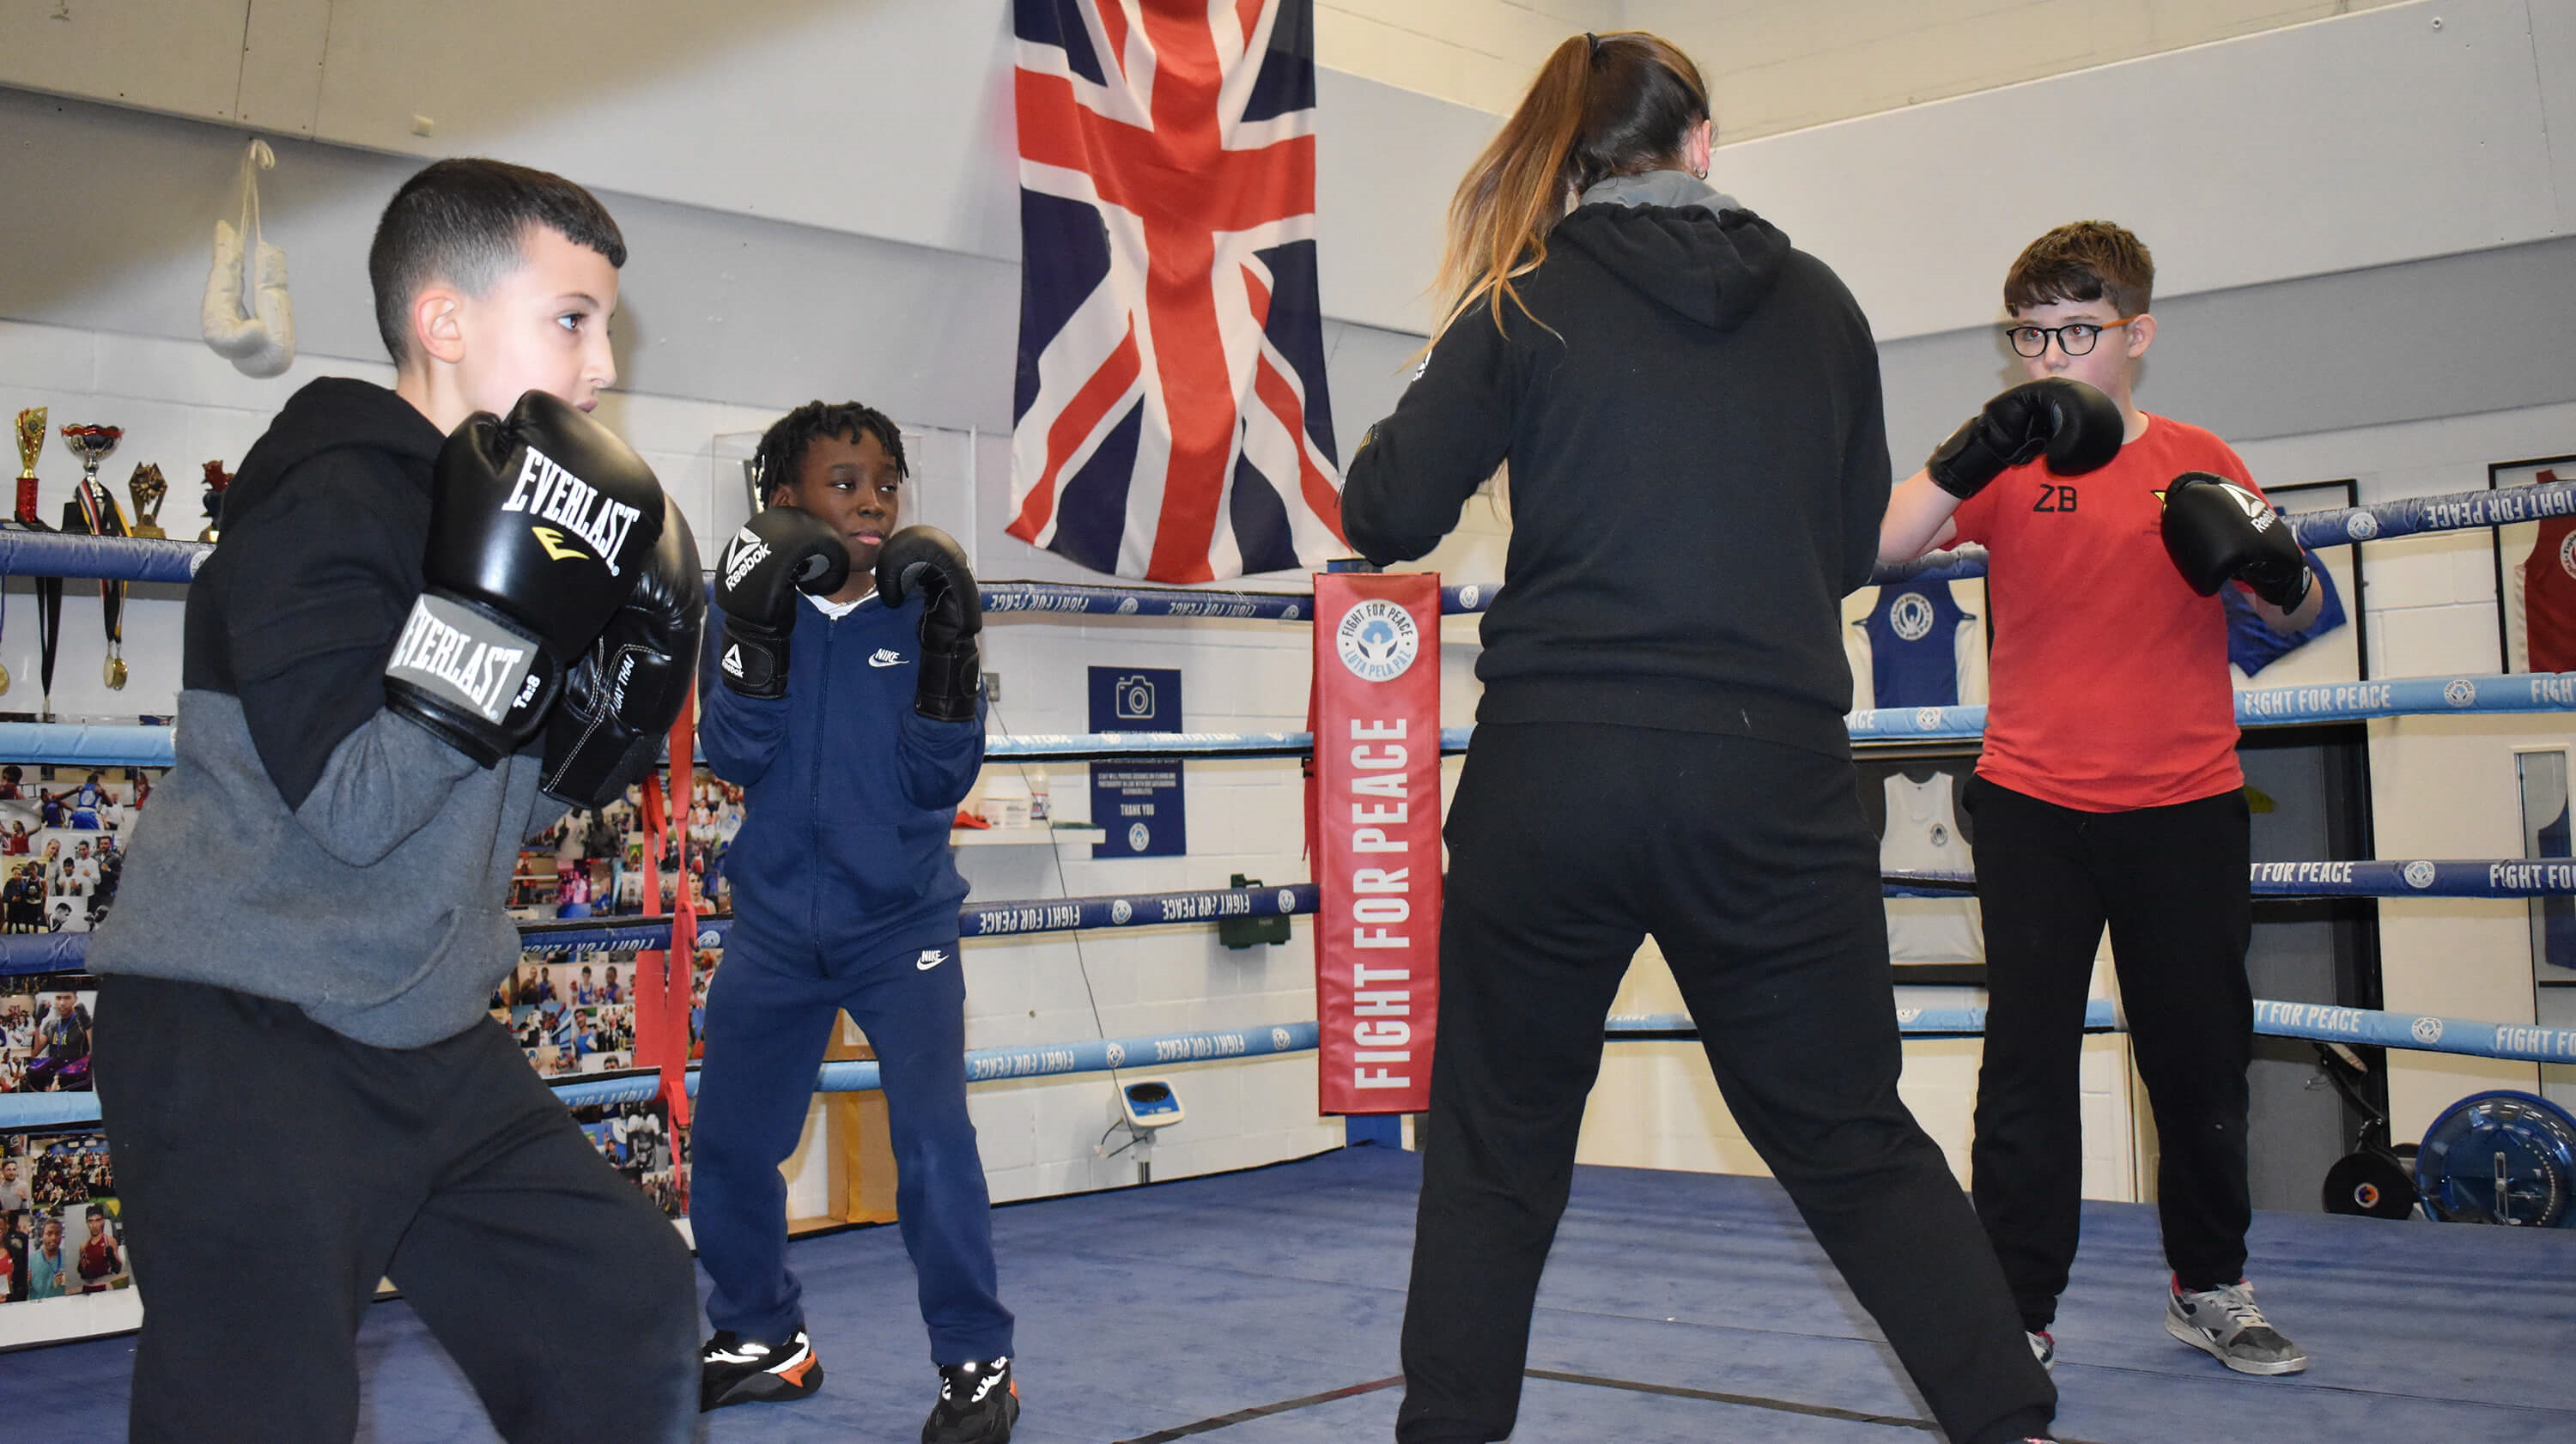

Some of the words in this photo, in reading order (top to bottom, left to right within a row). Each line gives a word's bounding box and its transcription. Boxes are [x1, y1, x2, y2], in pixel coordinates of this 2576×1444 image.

[501, 446, 641, 570] EVERLAST
[2033, 483, 2077, 513] ZB
[2488, 496, 2524, 522] FOR
[2530, 490, 2576, 517] IGHT
[2427, 501, 2484, 528] PEACE
[725, 543, 772, 592] Reebok
[1342, 609, 1364, 637] FIGHT
[1366, 604, 1385, 617] FOR
[1388, 607, 1413, 637] PEACE
[390, 597, 524, 719] EVERLAST
[875, 648, 900, 663] NIKE
[1345, 649, 1367, 673] LUTA
[1369, 663, 1394, 677] PELA
[1393, 650, 1411, 670] PAZ
[618, 653, 635, 685] THAI
[2245, 690, 2293, 715] FIGHT
[2299, 689, 2330, 712] FOR
[2336, 685, 2391, 710] PEACE
[1351, 719, 1408, 852] PEACE
[1120, 804, 1141, 816] THANK
[1142, 804, 1154, 816] YOU
[2262, 863, 2296, 883] FOR
[2298, 862, 2354, 883] PEACE
[2490, 864, 2542, 889] FIGHT
[2548, 865, 2576, 889] FO
[1045, 905, 1080, 928] FIGHT
[1161, 897, 1194, 920] PEACE
[1198, 895, 1218, 917] FOR
[1220, 894, 1250, 915] FIGHT
[1352, 867, 1410, 948] FOR
[978, 910, 1018, 934] PEACE
[1020, 908, 1043, 931] FOR
[921, 950, 941, 962] NIKE
[1353, 963, 1410, 1089] FIGHT
[2269, 1003, 2303, 1027] FOR
[2306, 1005, 2362, 1033] PEACE
[1154, 1038, 1190, 1061] PEACE
[1191, 1035, 1213, 1058] FOR
[1215, 1034, 1245, 1053] FIGHT
[2496, 1026, 2553, 1054] FIGHT
[974, 1055, 1012, 1080] PEACE
[1014, 1053, 1037, 1076] FOR
[1041, 1050, 1074, 1073] FIGHT
